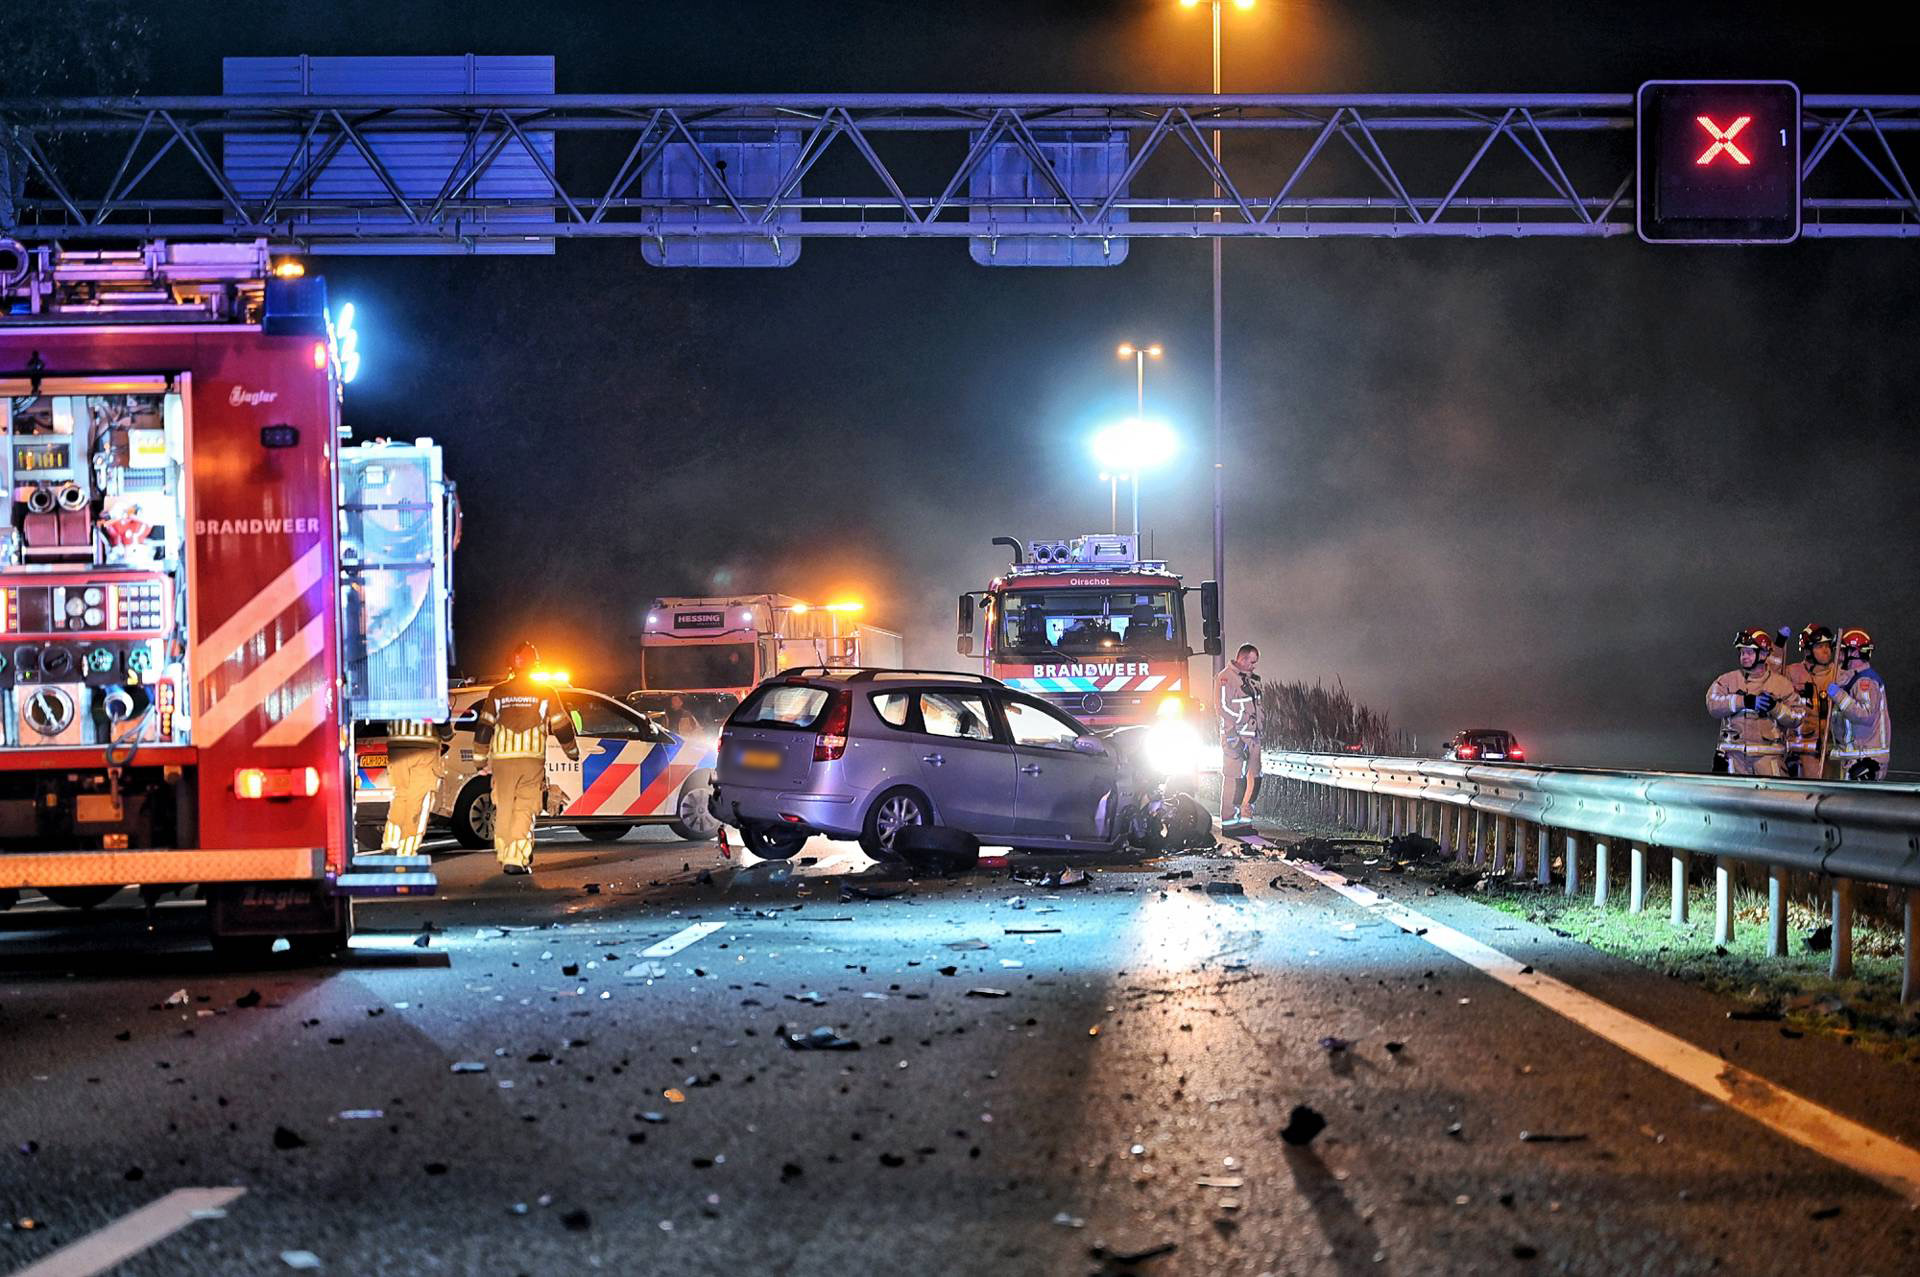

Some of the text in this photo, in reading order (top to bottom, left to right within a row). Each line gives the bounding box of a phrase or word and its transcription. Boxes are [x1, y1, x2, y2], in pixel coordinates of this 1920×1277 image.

[1779, 128, 1787, 147] 1
[195, 517, 320, 535] BRANDWEER
[1070, 577, 1111, 587] Oirschot
[677, 614, 721, 624] HESSING
[1032, 662, 1151, 678] BRANDWEER
[544, 762, 580, 772] LITIE
